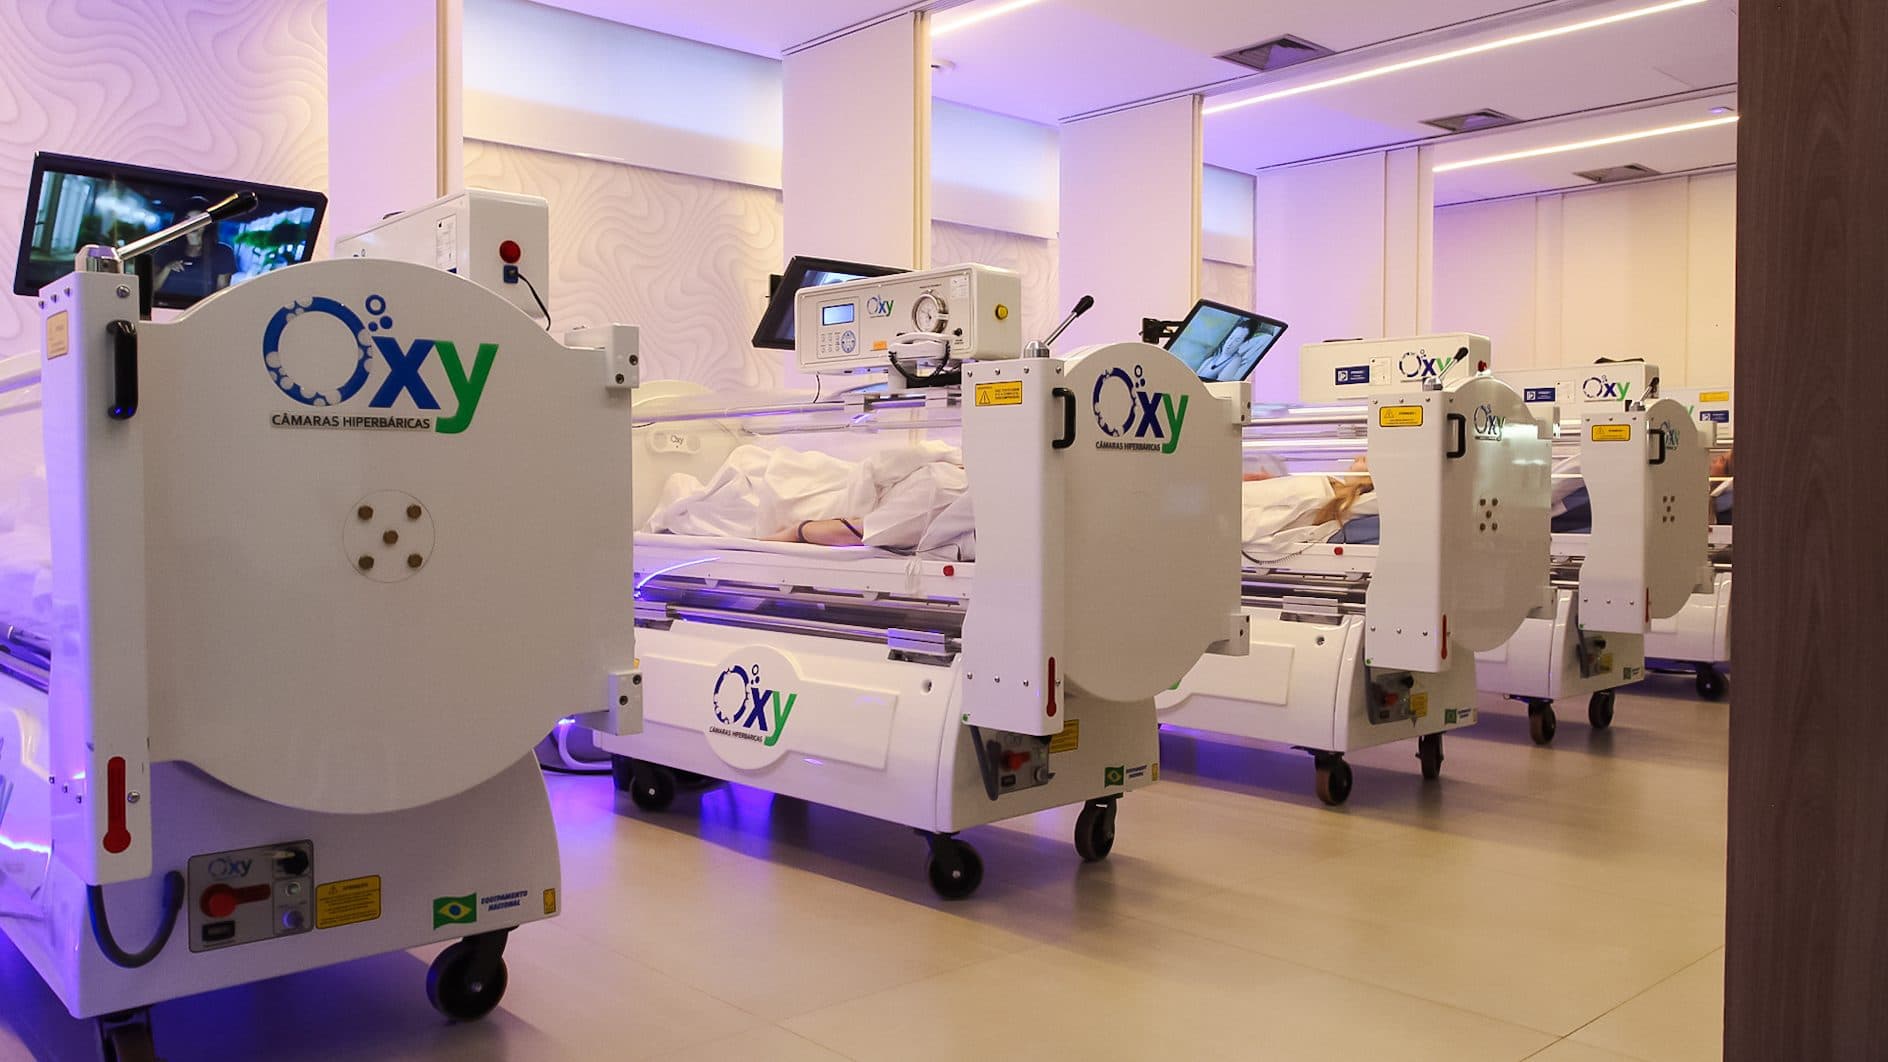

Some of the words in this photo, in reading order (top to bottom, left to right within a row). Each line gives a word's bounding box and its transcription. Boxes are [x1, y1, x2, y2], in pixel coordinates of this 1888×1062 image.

[867, 295, 894, 317] Oxy
[263, 295, 499, 434] Oxy
[1583, 375, 1630, 402] Oxy
[272, 413, 339, 427] CÂMARAS
[343, 415, 430, 429] HIPERBÁRICAS
[1093, 365, 1189, 454] Oxy
[714, 664, 797, 746] Oxy
[208, 856, 251, 878] Oxy
